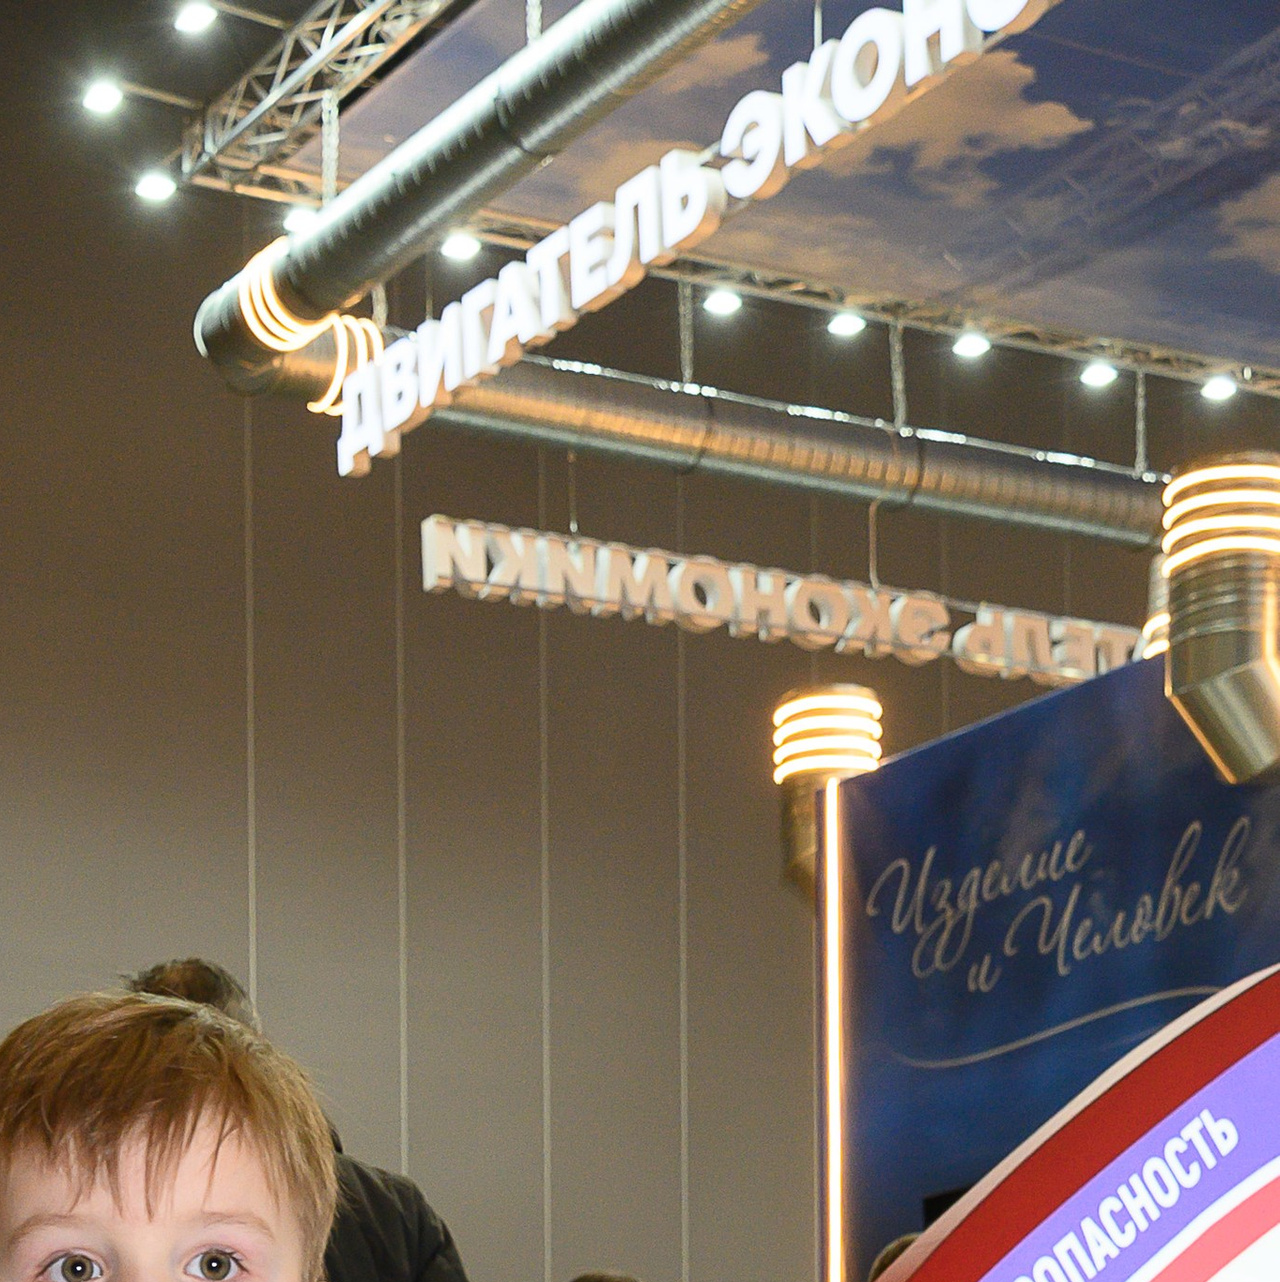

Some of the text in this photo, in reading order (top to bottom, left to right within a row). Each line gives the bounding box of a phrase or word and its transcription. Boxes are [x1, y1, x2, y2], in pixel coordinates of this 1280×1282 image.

[337, 150, 714, 478] ДВИГАТЕЛЬ
[866, 829, 1092, 977] Изделие
[967, 816, 1250, 993] и Человек
